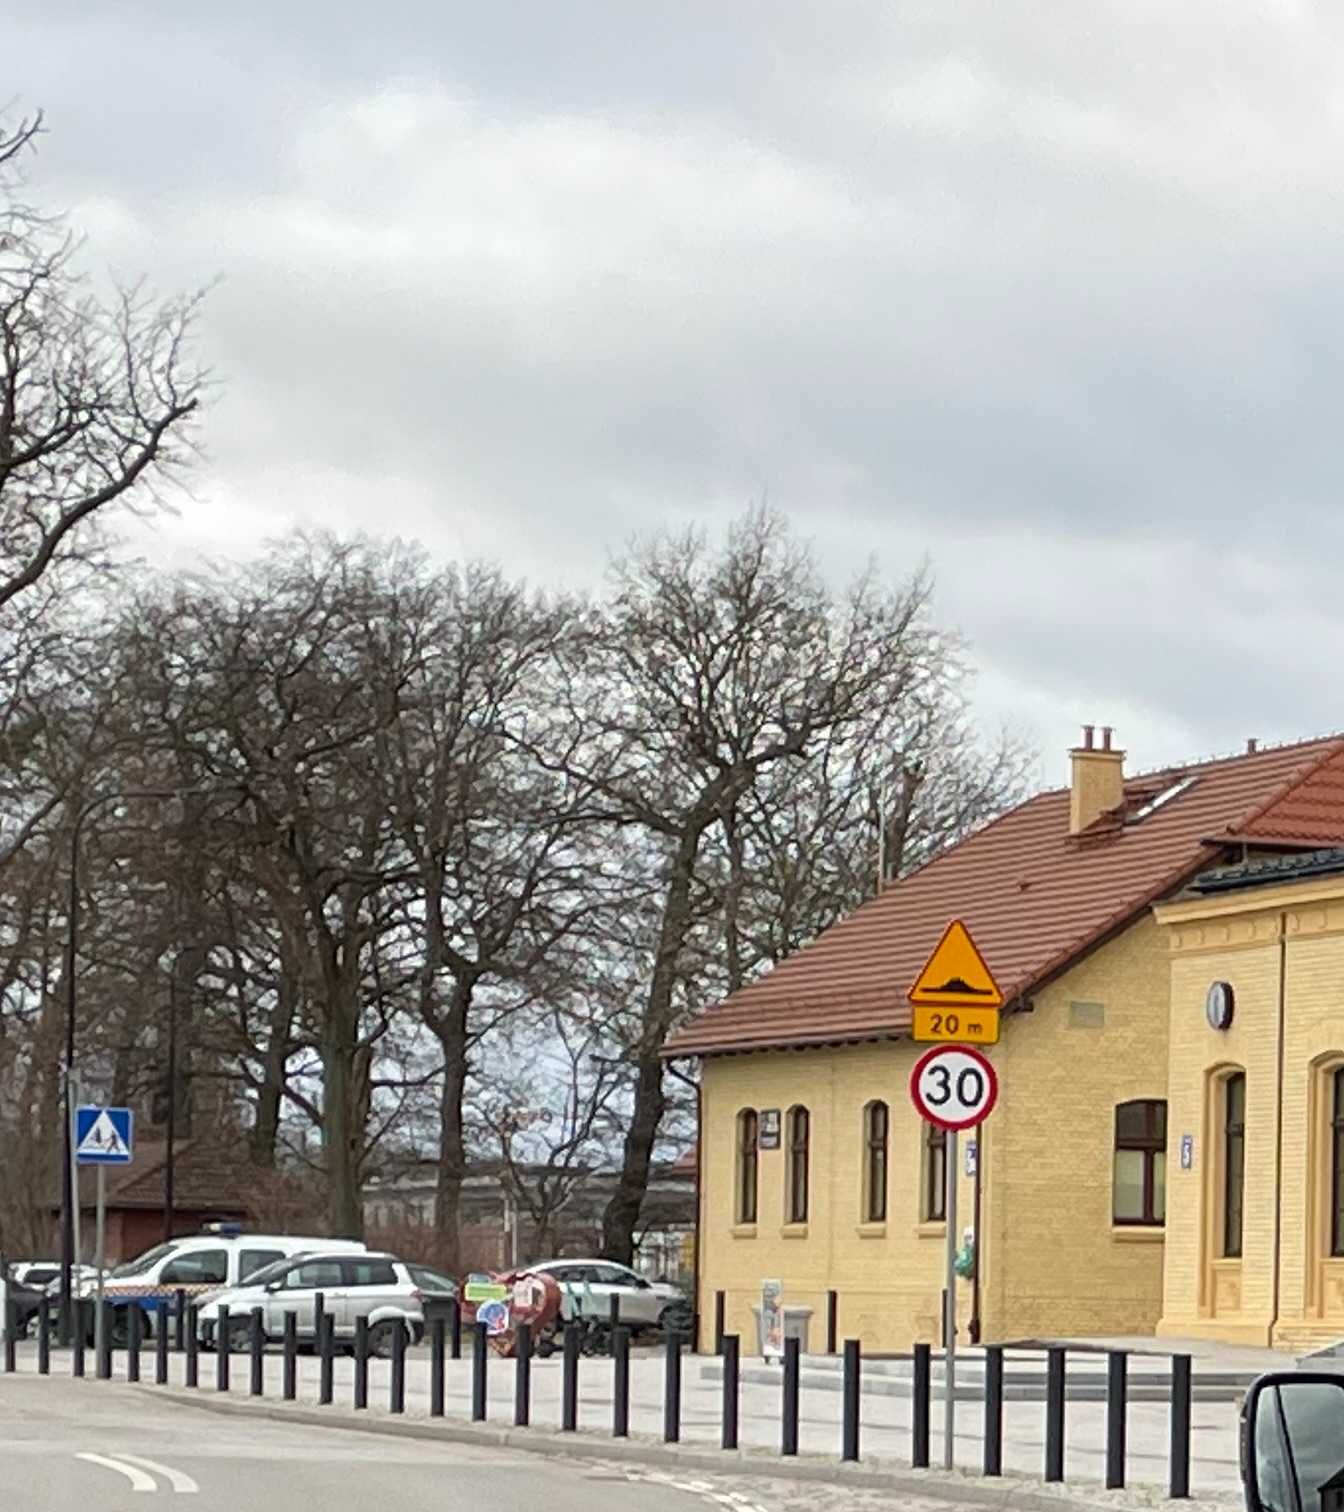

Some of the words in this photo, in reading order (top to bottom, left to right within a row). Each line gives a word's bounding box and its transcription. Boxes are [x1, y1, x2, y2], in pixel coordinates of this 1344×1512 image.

[930, 1014, 959, 1034] 20
[967, 1023, 983, 1035] m
[926, 1065, 984, 1108] 30
